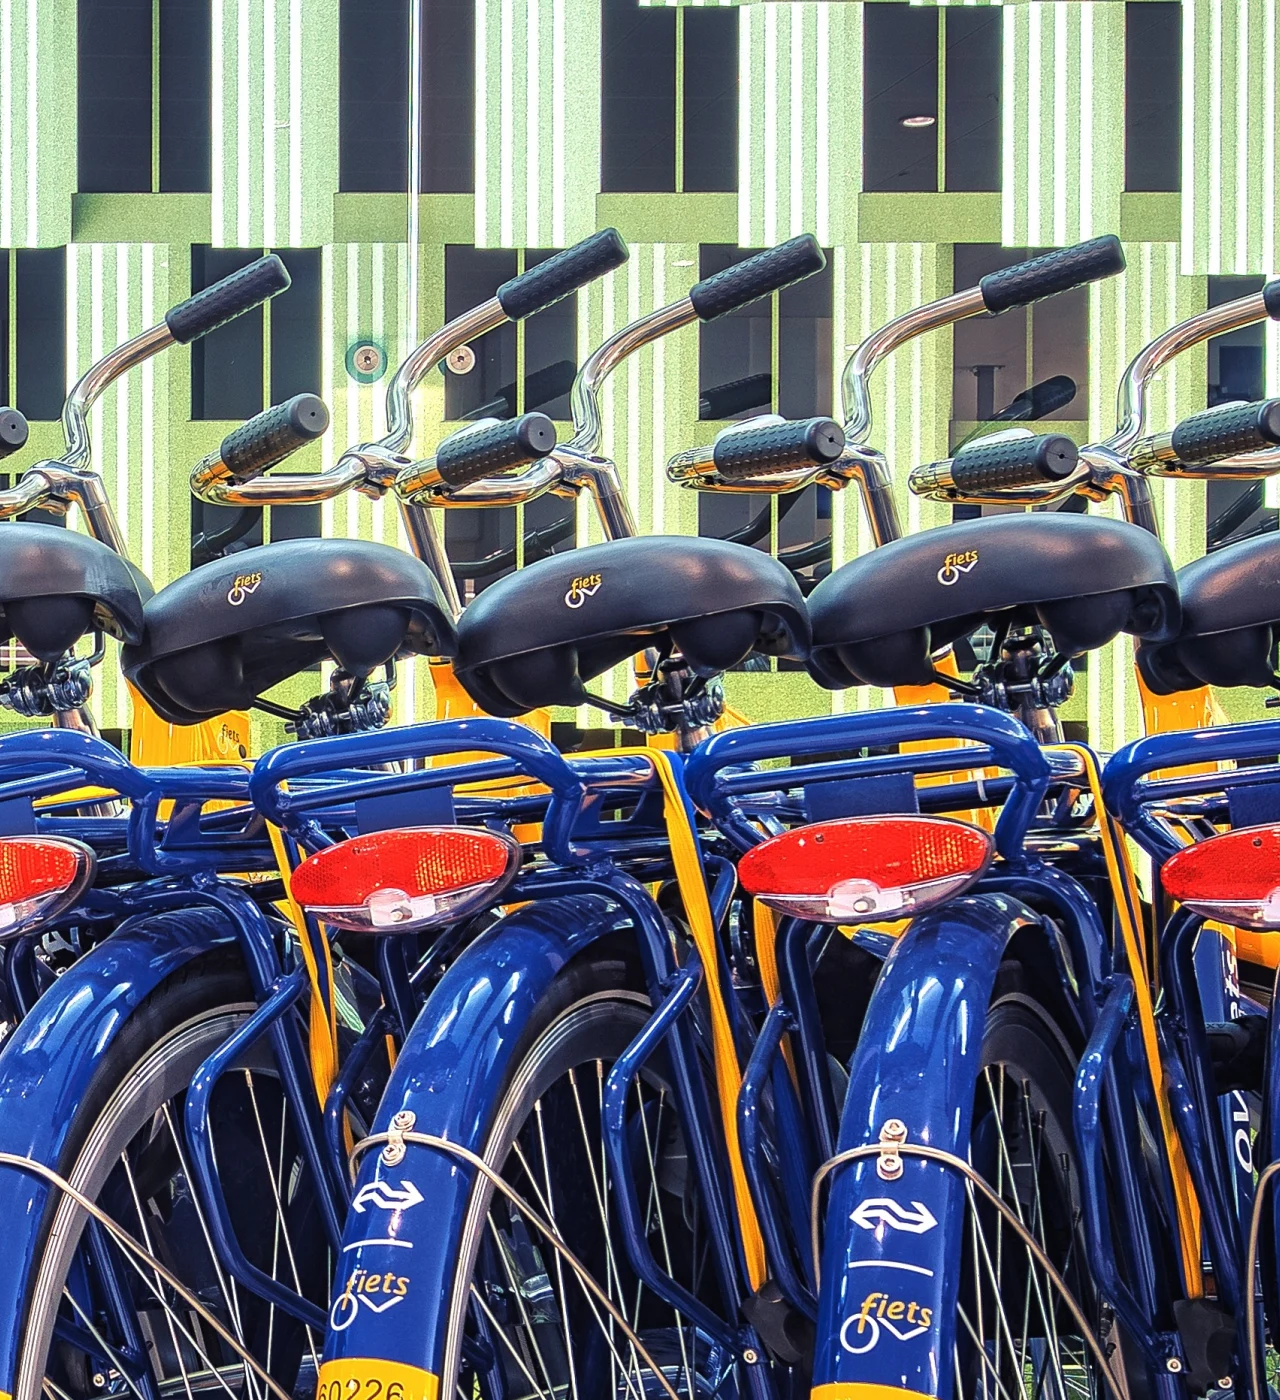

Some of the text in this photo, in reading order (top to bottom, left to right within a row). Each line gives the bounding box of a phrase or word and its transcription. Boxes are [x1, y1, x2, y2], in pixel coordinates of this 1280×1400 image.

[944, 550, 978, 576] fiets
[234, 572, 262, 597] fiets
[571, 573, 602, 600] fiets
[340, 1269, 410, 1311] fiets
[857, 1292, 933, 1334] fiets
